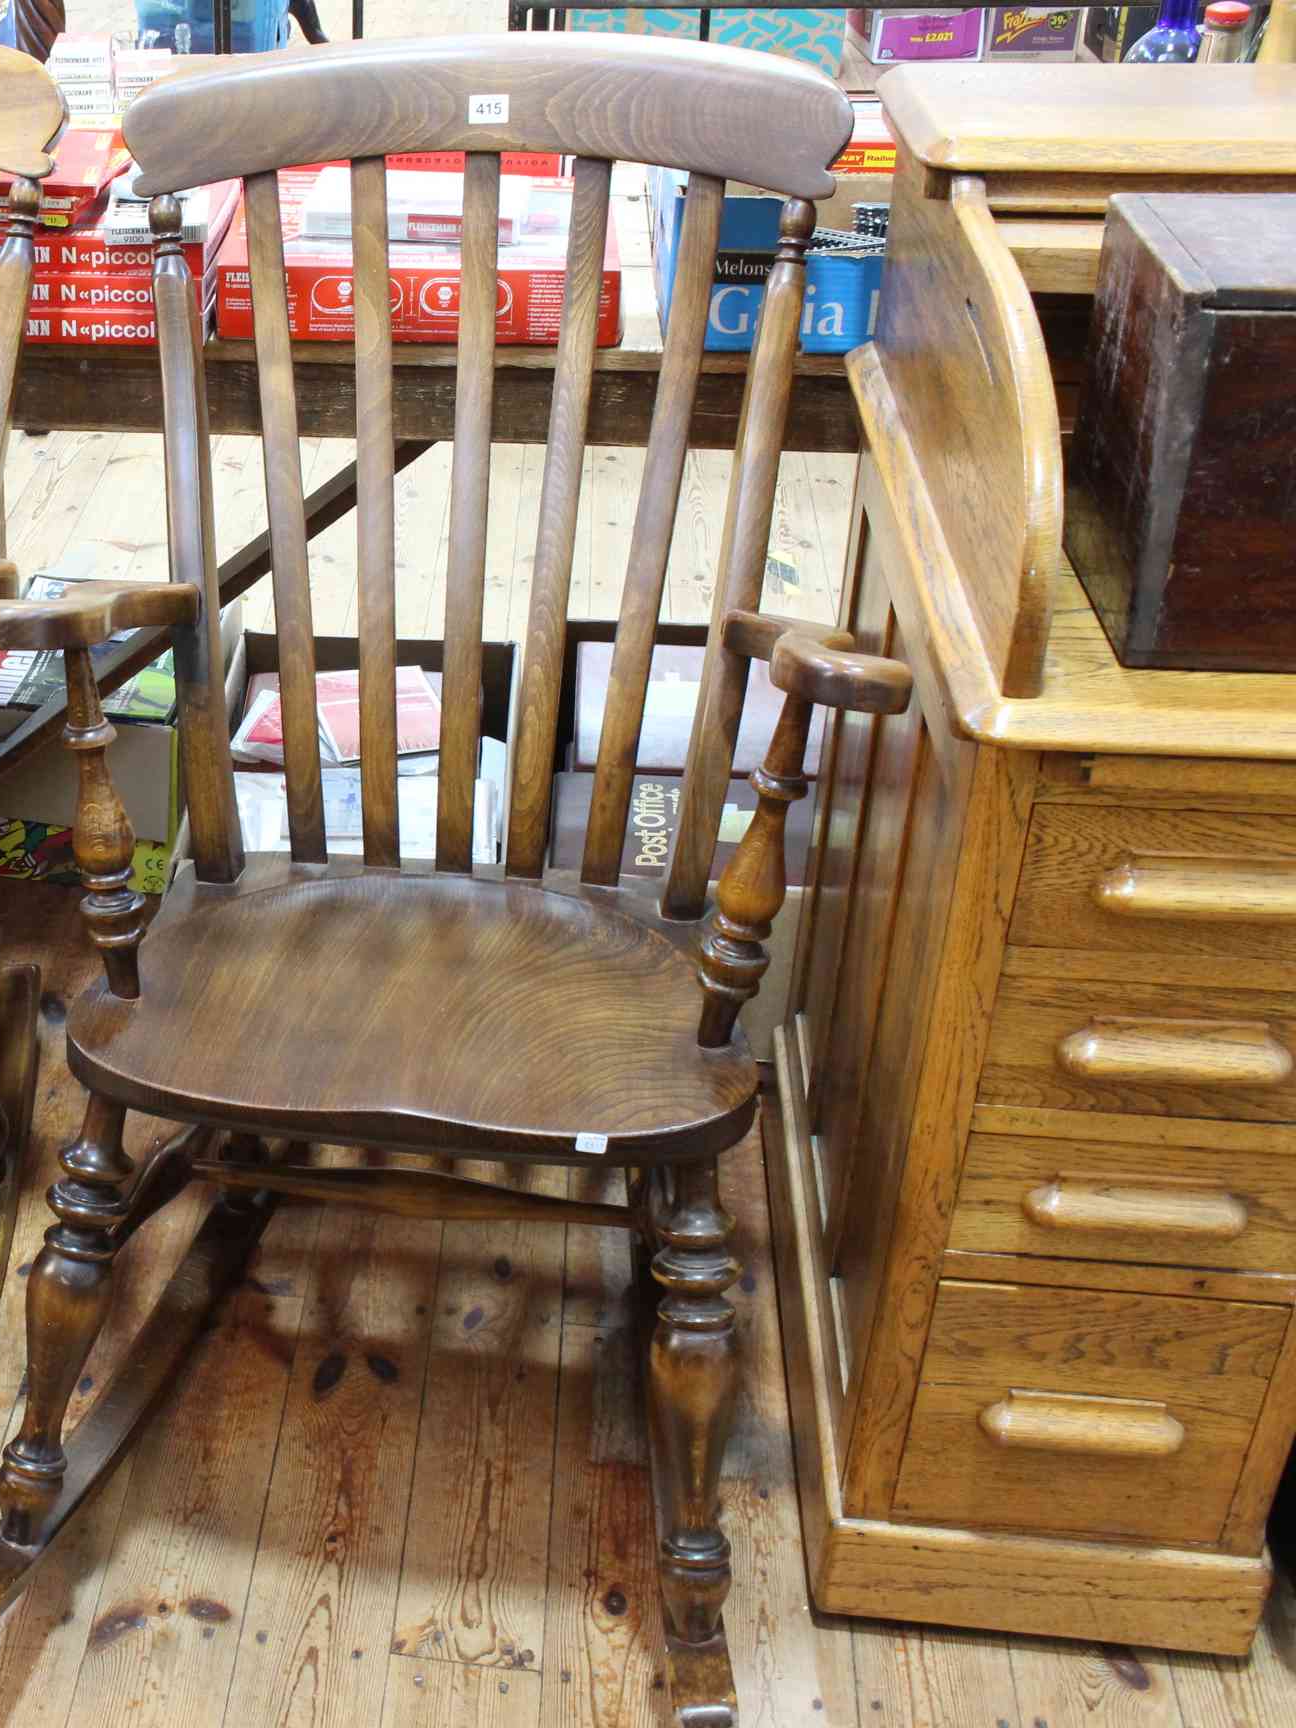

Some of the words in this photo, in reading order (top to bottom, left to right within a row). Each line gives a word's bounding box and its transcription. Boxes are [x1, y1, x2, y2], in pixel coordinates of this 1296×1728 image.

[475, 102, 502, 115] 415
[632, 782, 667, 828] Office
[634, 828, 669, 867] Post
